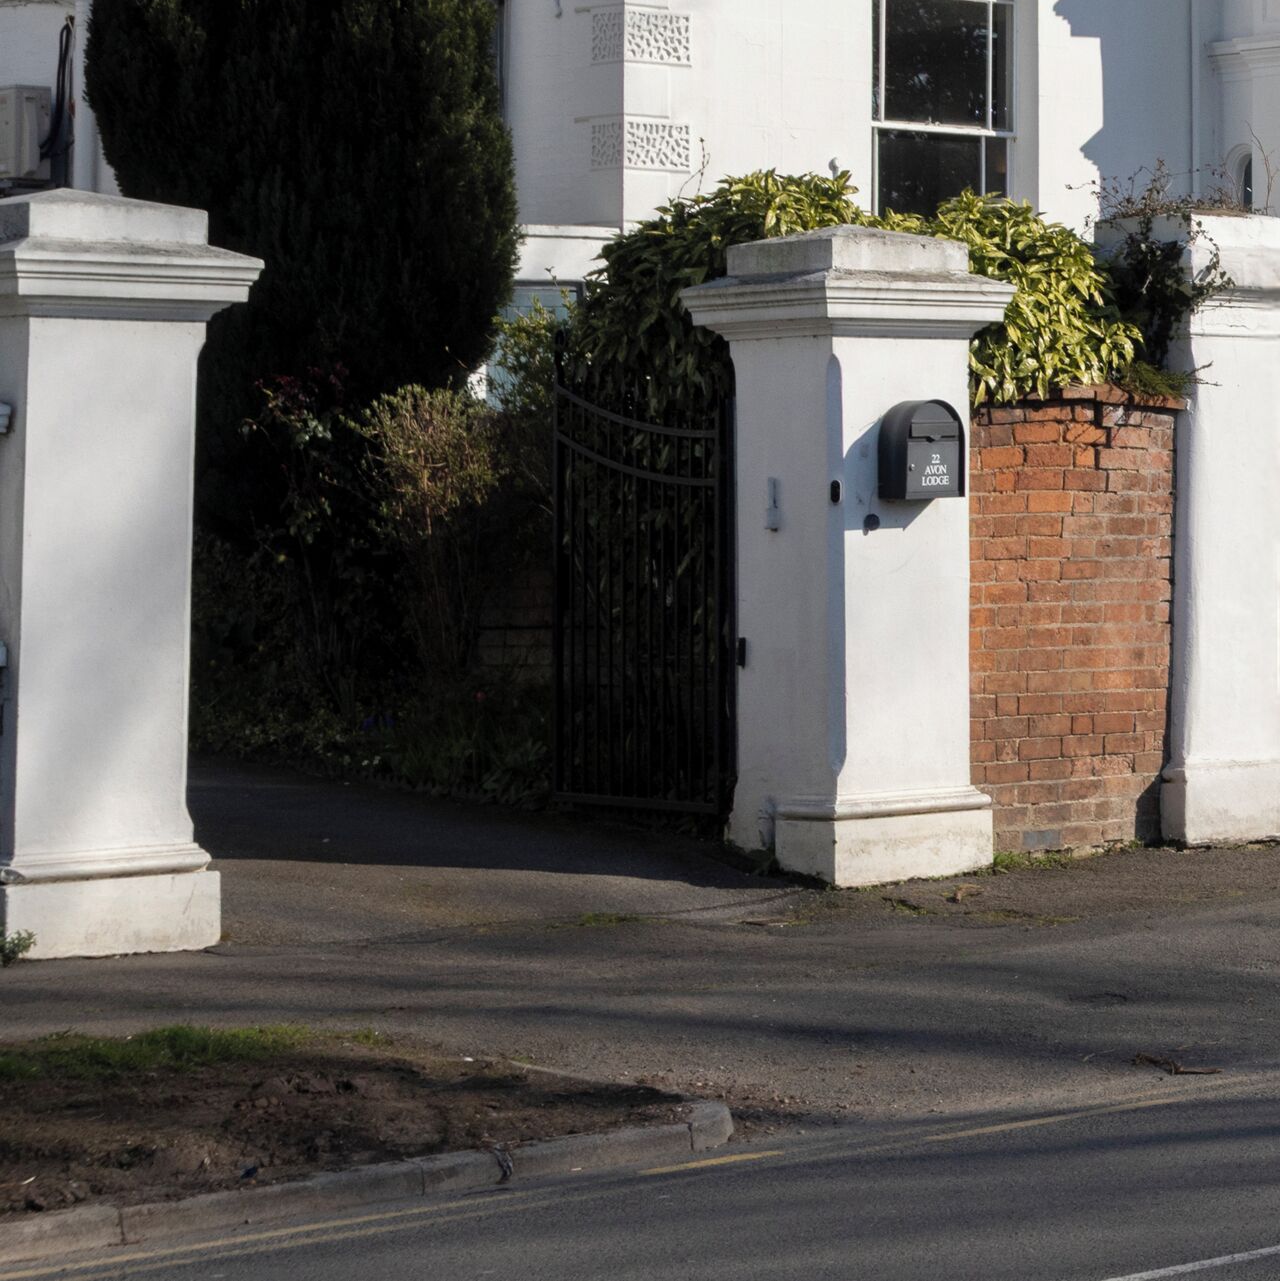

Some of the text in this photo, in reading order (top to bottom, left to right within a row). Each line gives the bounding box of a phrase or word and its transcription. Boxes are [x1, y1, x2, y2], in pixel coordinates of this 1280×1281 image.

[931, 454, 940, 464] 22
[925, 465, 947, 475] AVON
[921, 475, 950, 486] LODGE
